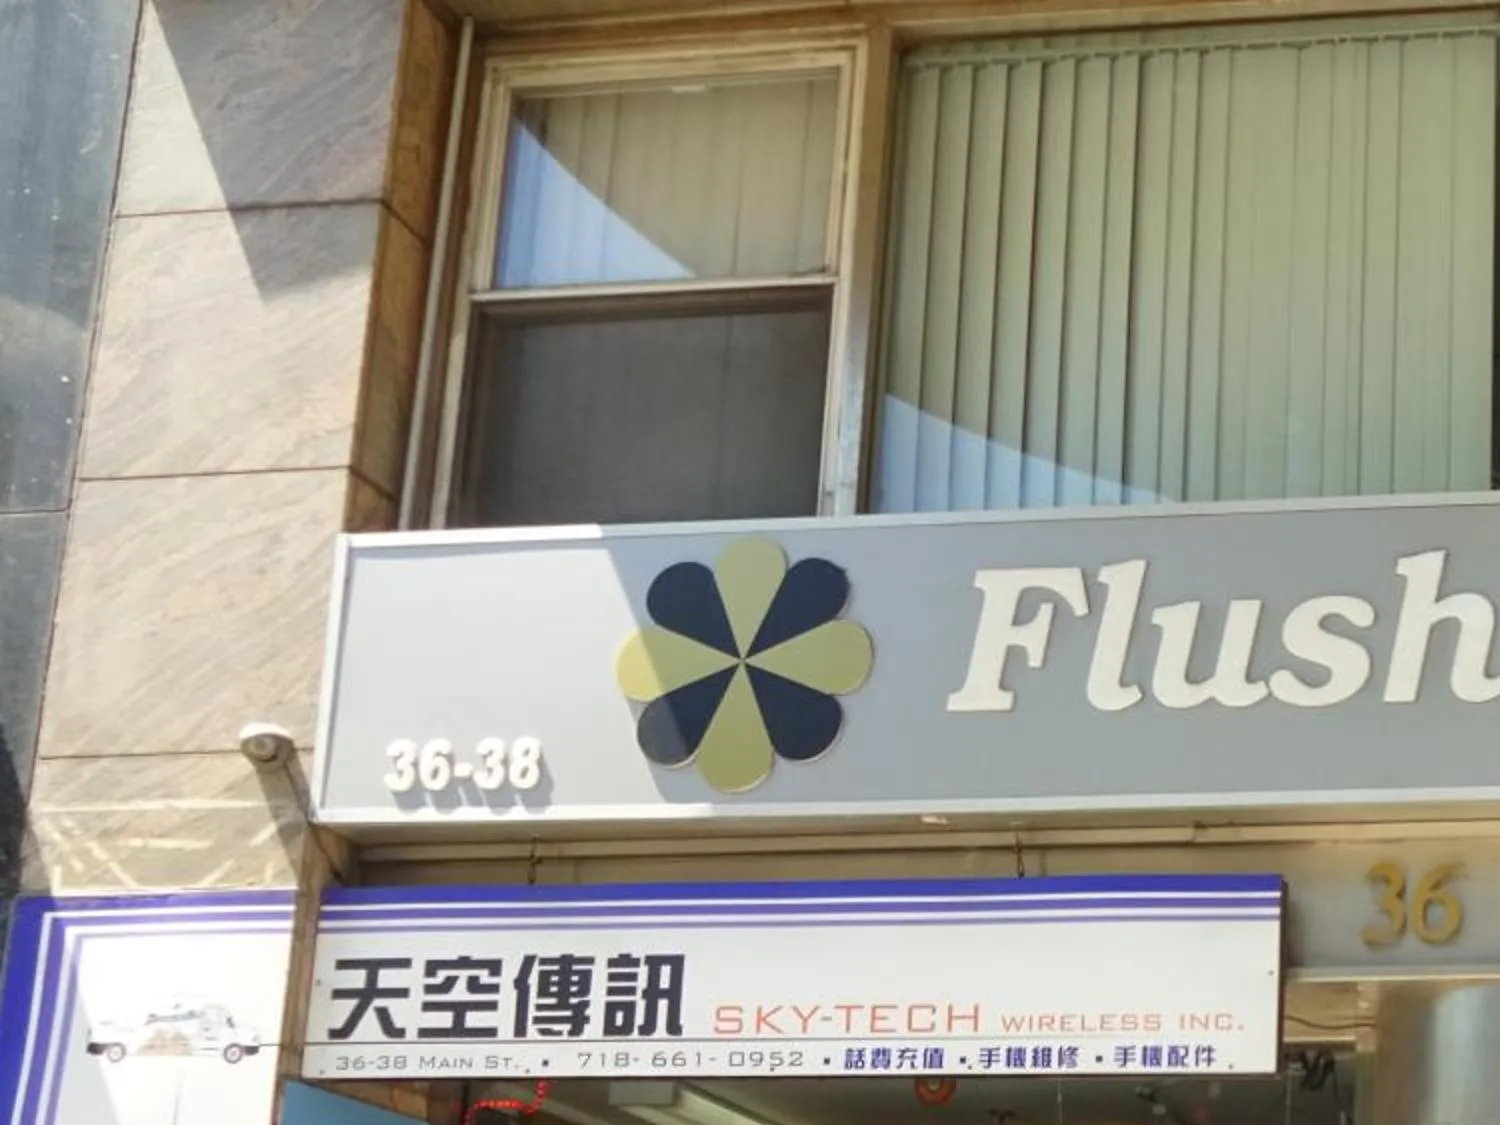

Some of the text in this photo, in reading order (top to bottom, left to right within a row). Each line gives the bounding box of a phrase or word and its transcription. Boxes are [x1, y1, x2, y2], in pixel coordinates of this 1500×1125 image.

[383, 735, 544, 793] 36-38
[327, 953, 686, 1040] 天空傳訊
[713, 1003, 1246, 1037] SKY-TECH WIRELESS INC.
[335, 1054, 408, 1071] 36-38
[418, 1055, 474, 1070] MAIN
[483, 1054, 521, 1071] ST.
[844, 1044, 1218, 1069] 話費充值 手機維修 手機配件
